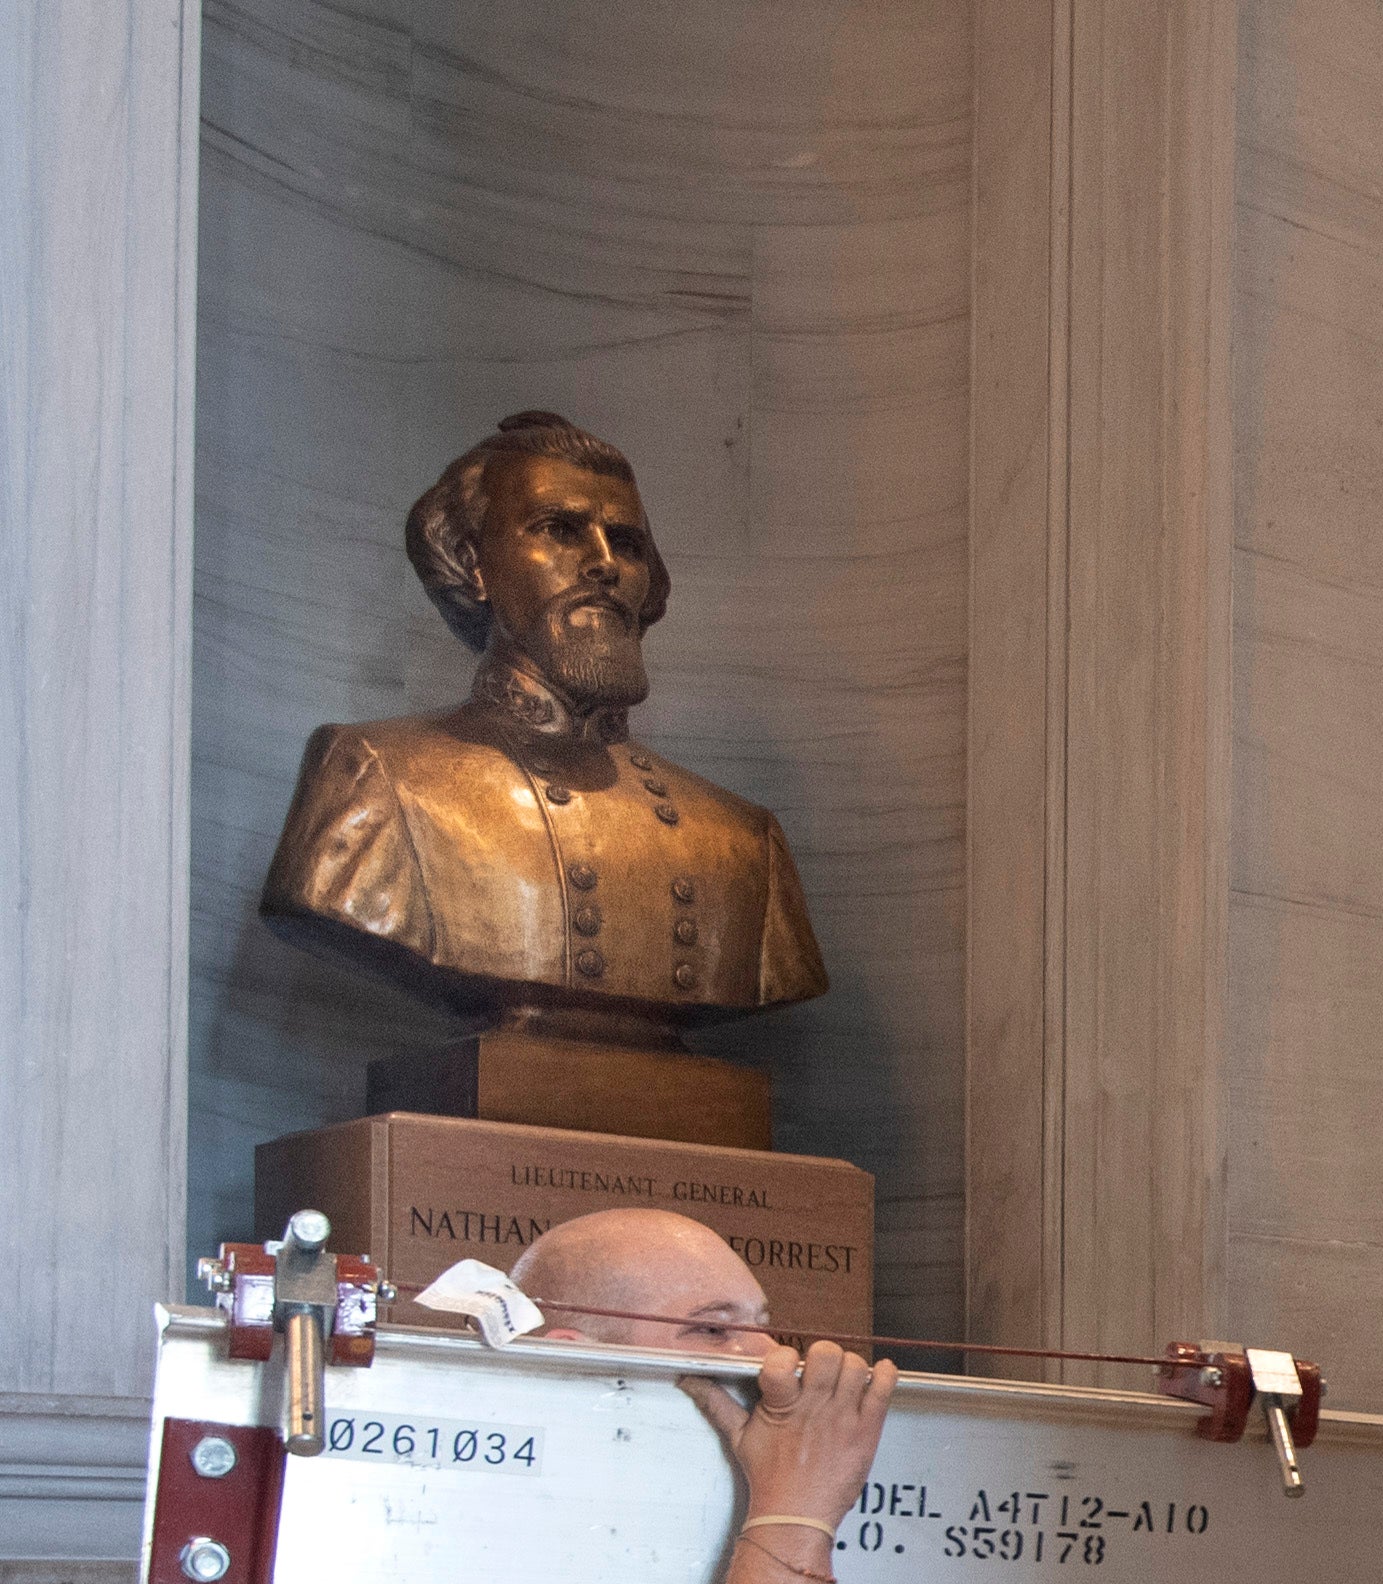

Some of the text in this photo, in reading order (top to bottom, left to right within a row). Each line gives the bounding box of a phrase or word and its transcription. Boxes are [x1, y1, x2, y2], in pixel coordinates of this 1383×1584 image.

[511, 1164, 773, 1209] LIEUTENANT GENERAL
[410, 1206, 857, 1273] NATHAN FORREST
[329, 1418, 536, 1467] 0261034
[860, 1482, 1210, 1534] DEL A4T12-A10
[944, 1526, 1106, 1566] S59178
